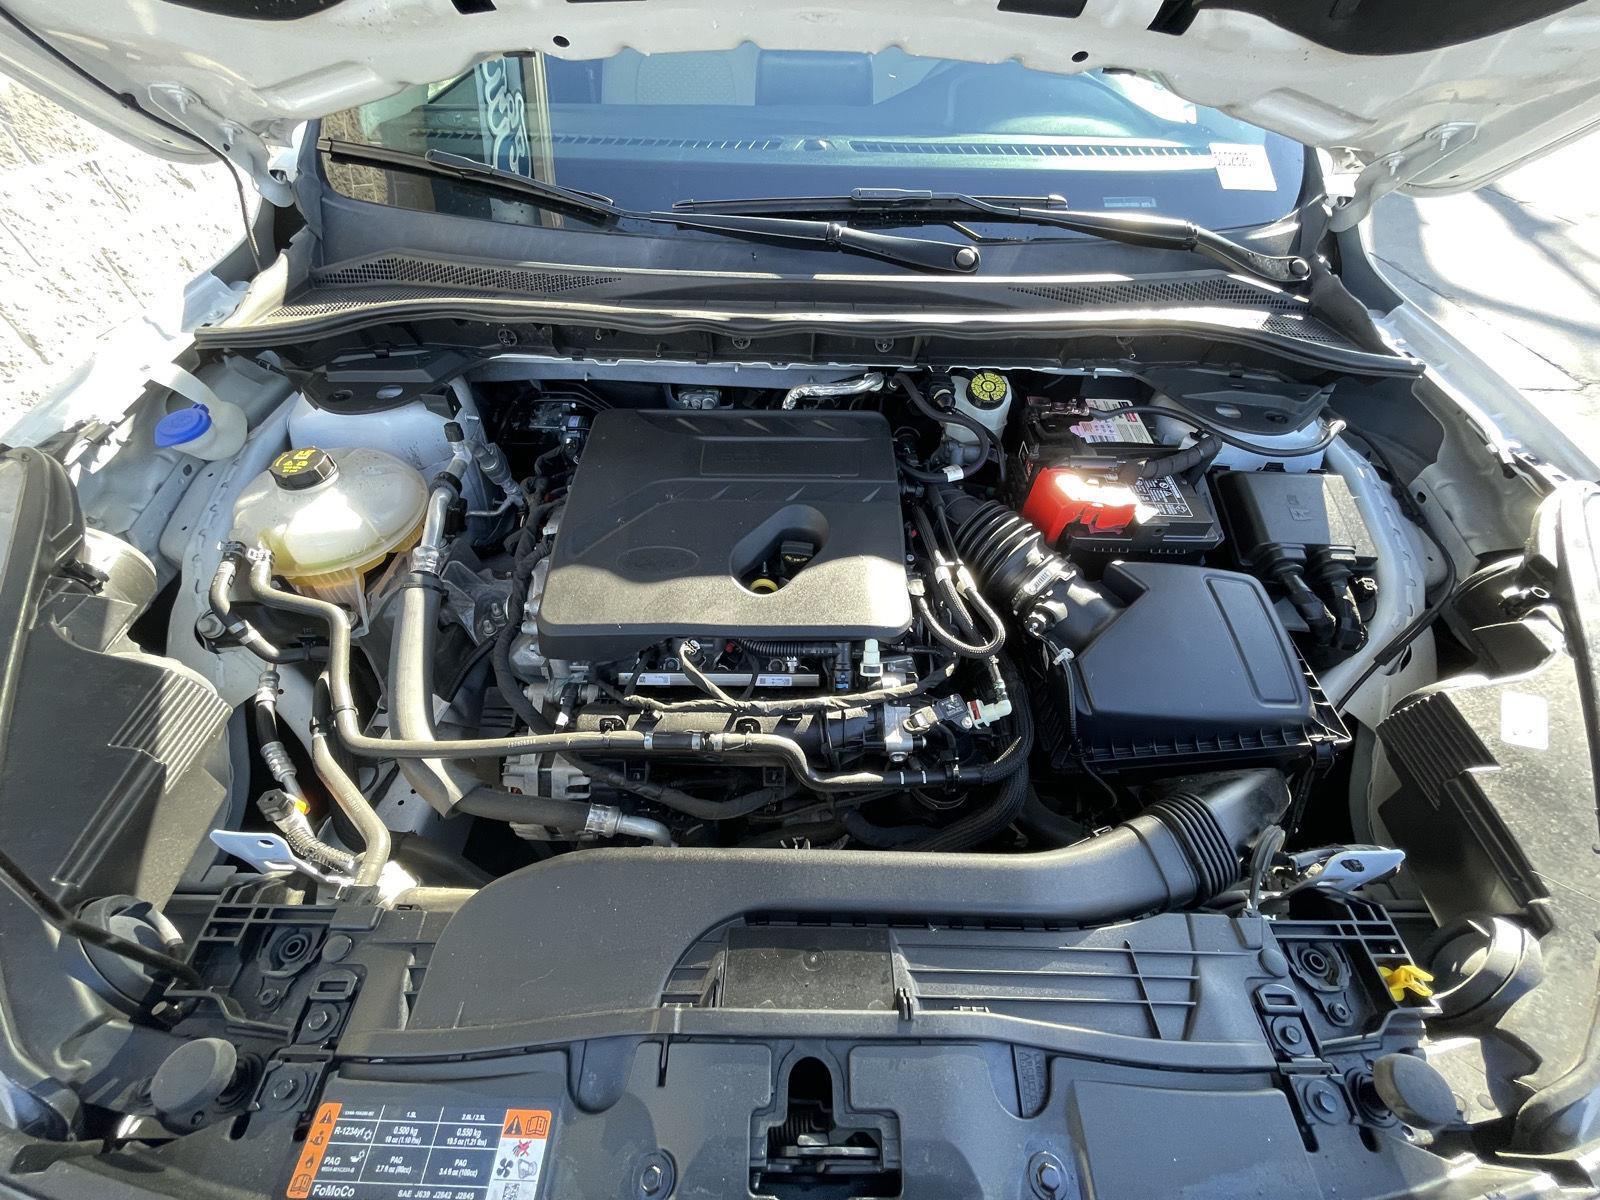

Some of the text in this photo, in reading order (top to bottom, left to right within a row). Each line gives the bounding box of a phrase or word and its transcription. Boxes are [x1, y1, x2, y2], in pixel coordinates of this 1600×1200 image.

[334, 1126, 365, 1138] R-1234yf
[393, 1126, 419, 1137] 0.500 kg
[456, 1128, 482, 1139] 0.550 kg
[323, 1156, 341, 1165] PAG
[390, 1156, 404, 1164] PAG
[454, 1159, 468, 1167] PAG
[312, 1184, 355, 1197] FoMoCo
[397, 1190, 412, 1198] SAE
[414, 1190, 431, 1199] J639
